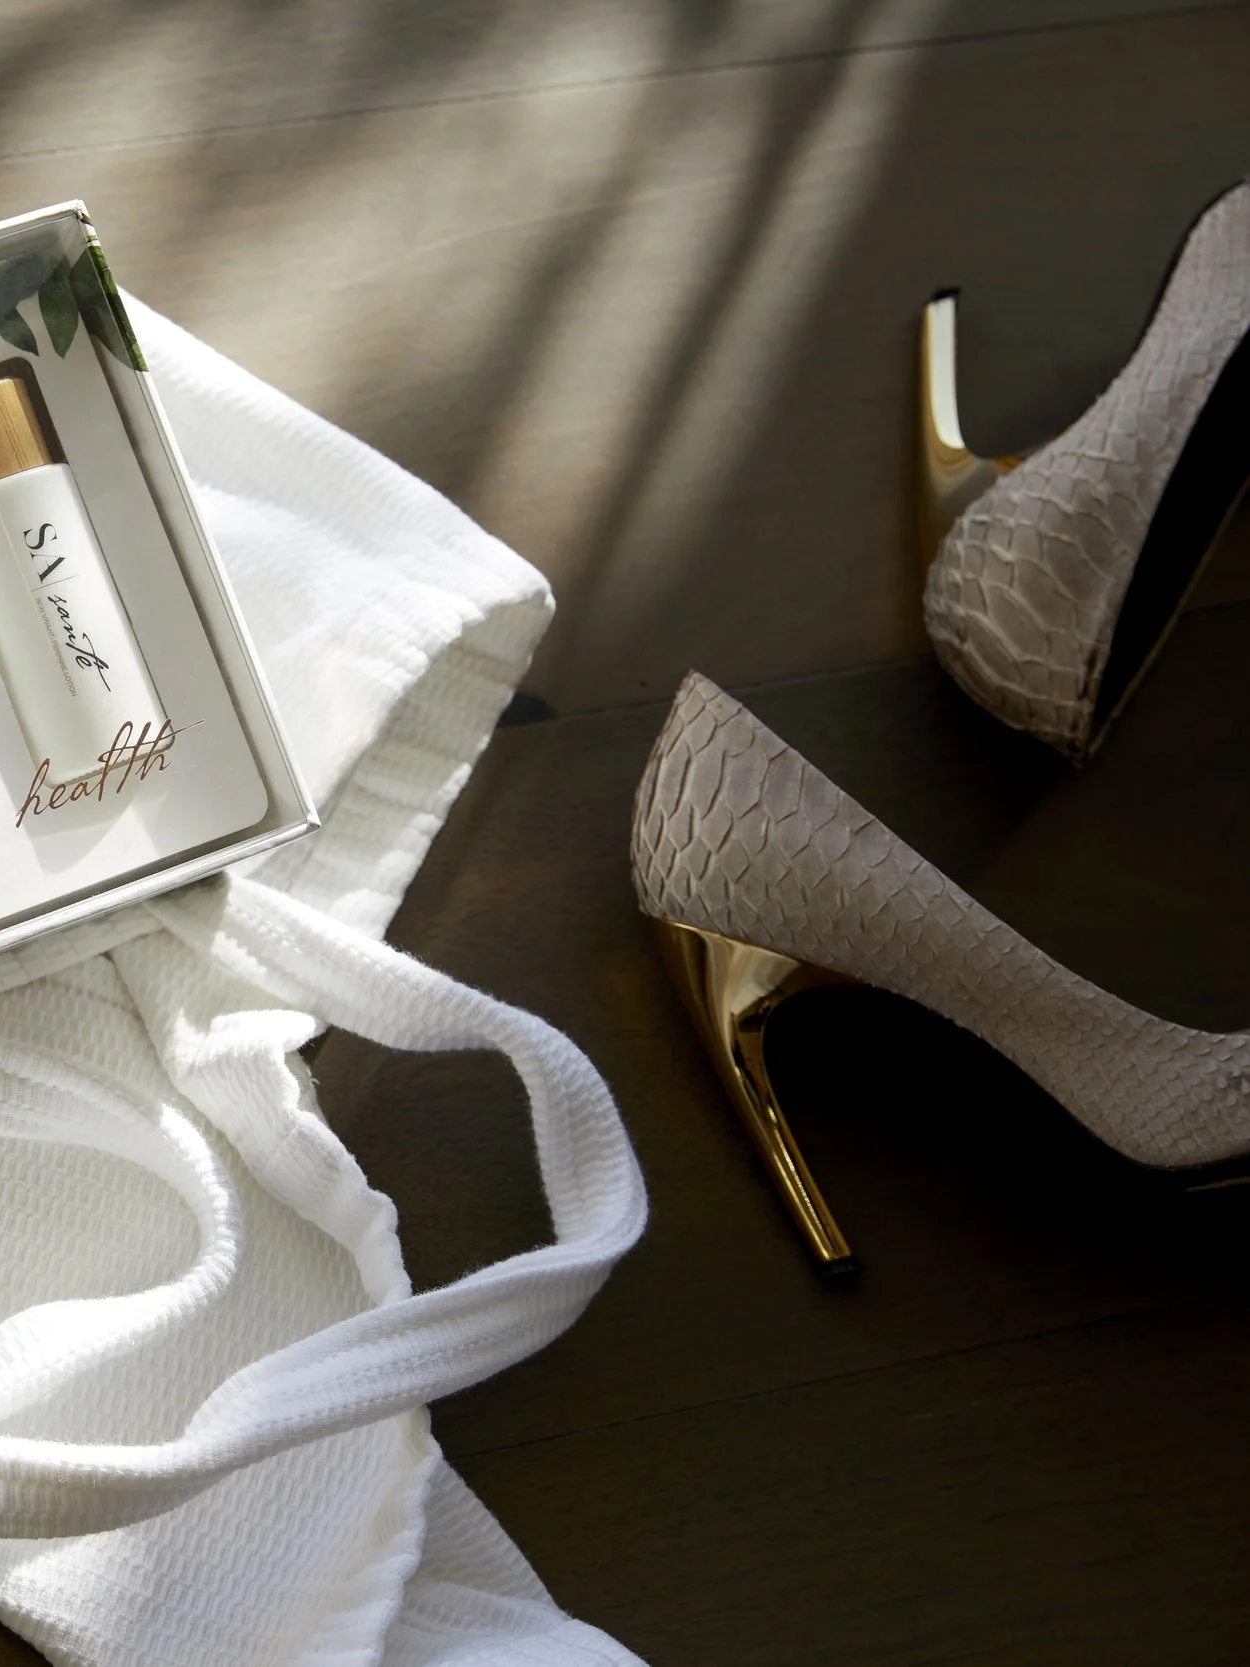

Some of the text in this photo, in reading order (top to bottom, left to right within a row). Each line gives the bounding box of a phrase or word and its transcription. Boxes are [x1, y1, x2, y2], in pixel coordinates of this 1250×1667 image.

[23, 522, 66, 584] SA
[63, 671, 78, 698] LOTION
[15, 718, 205, 829] health
